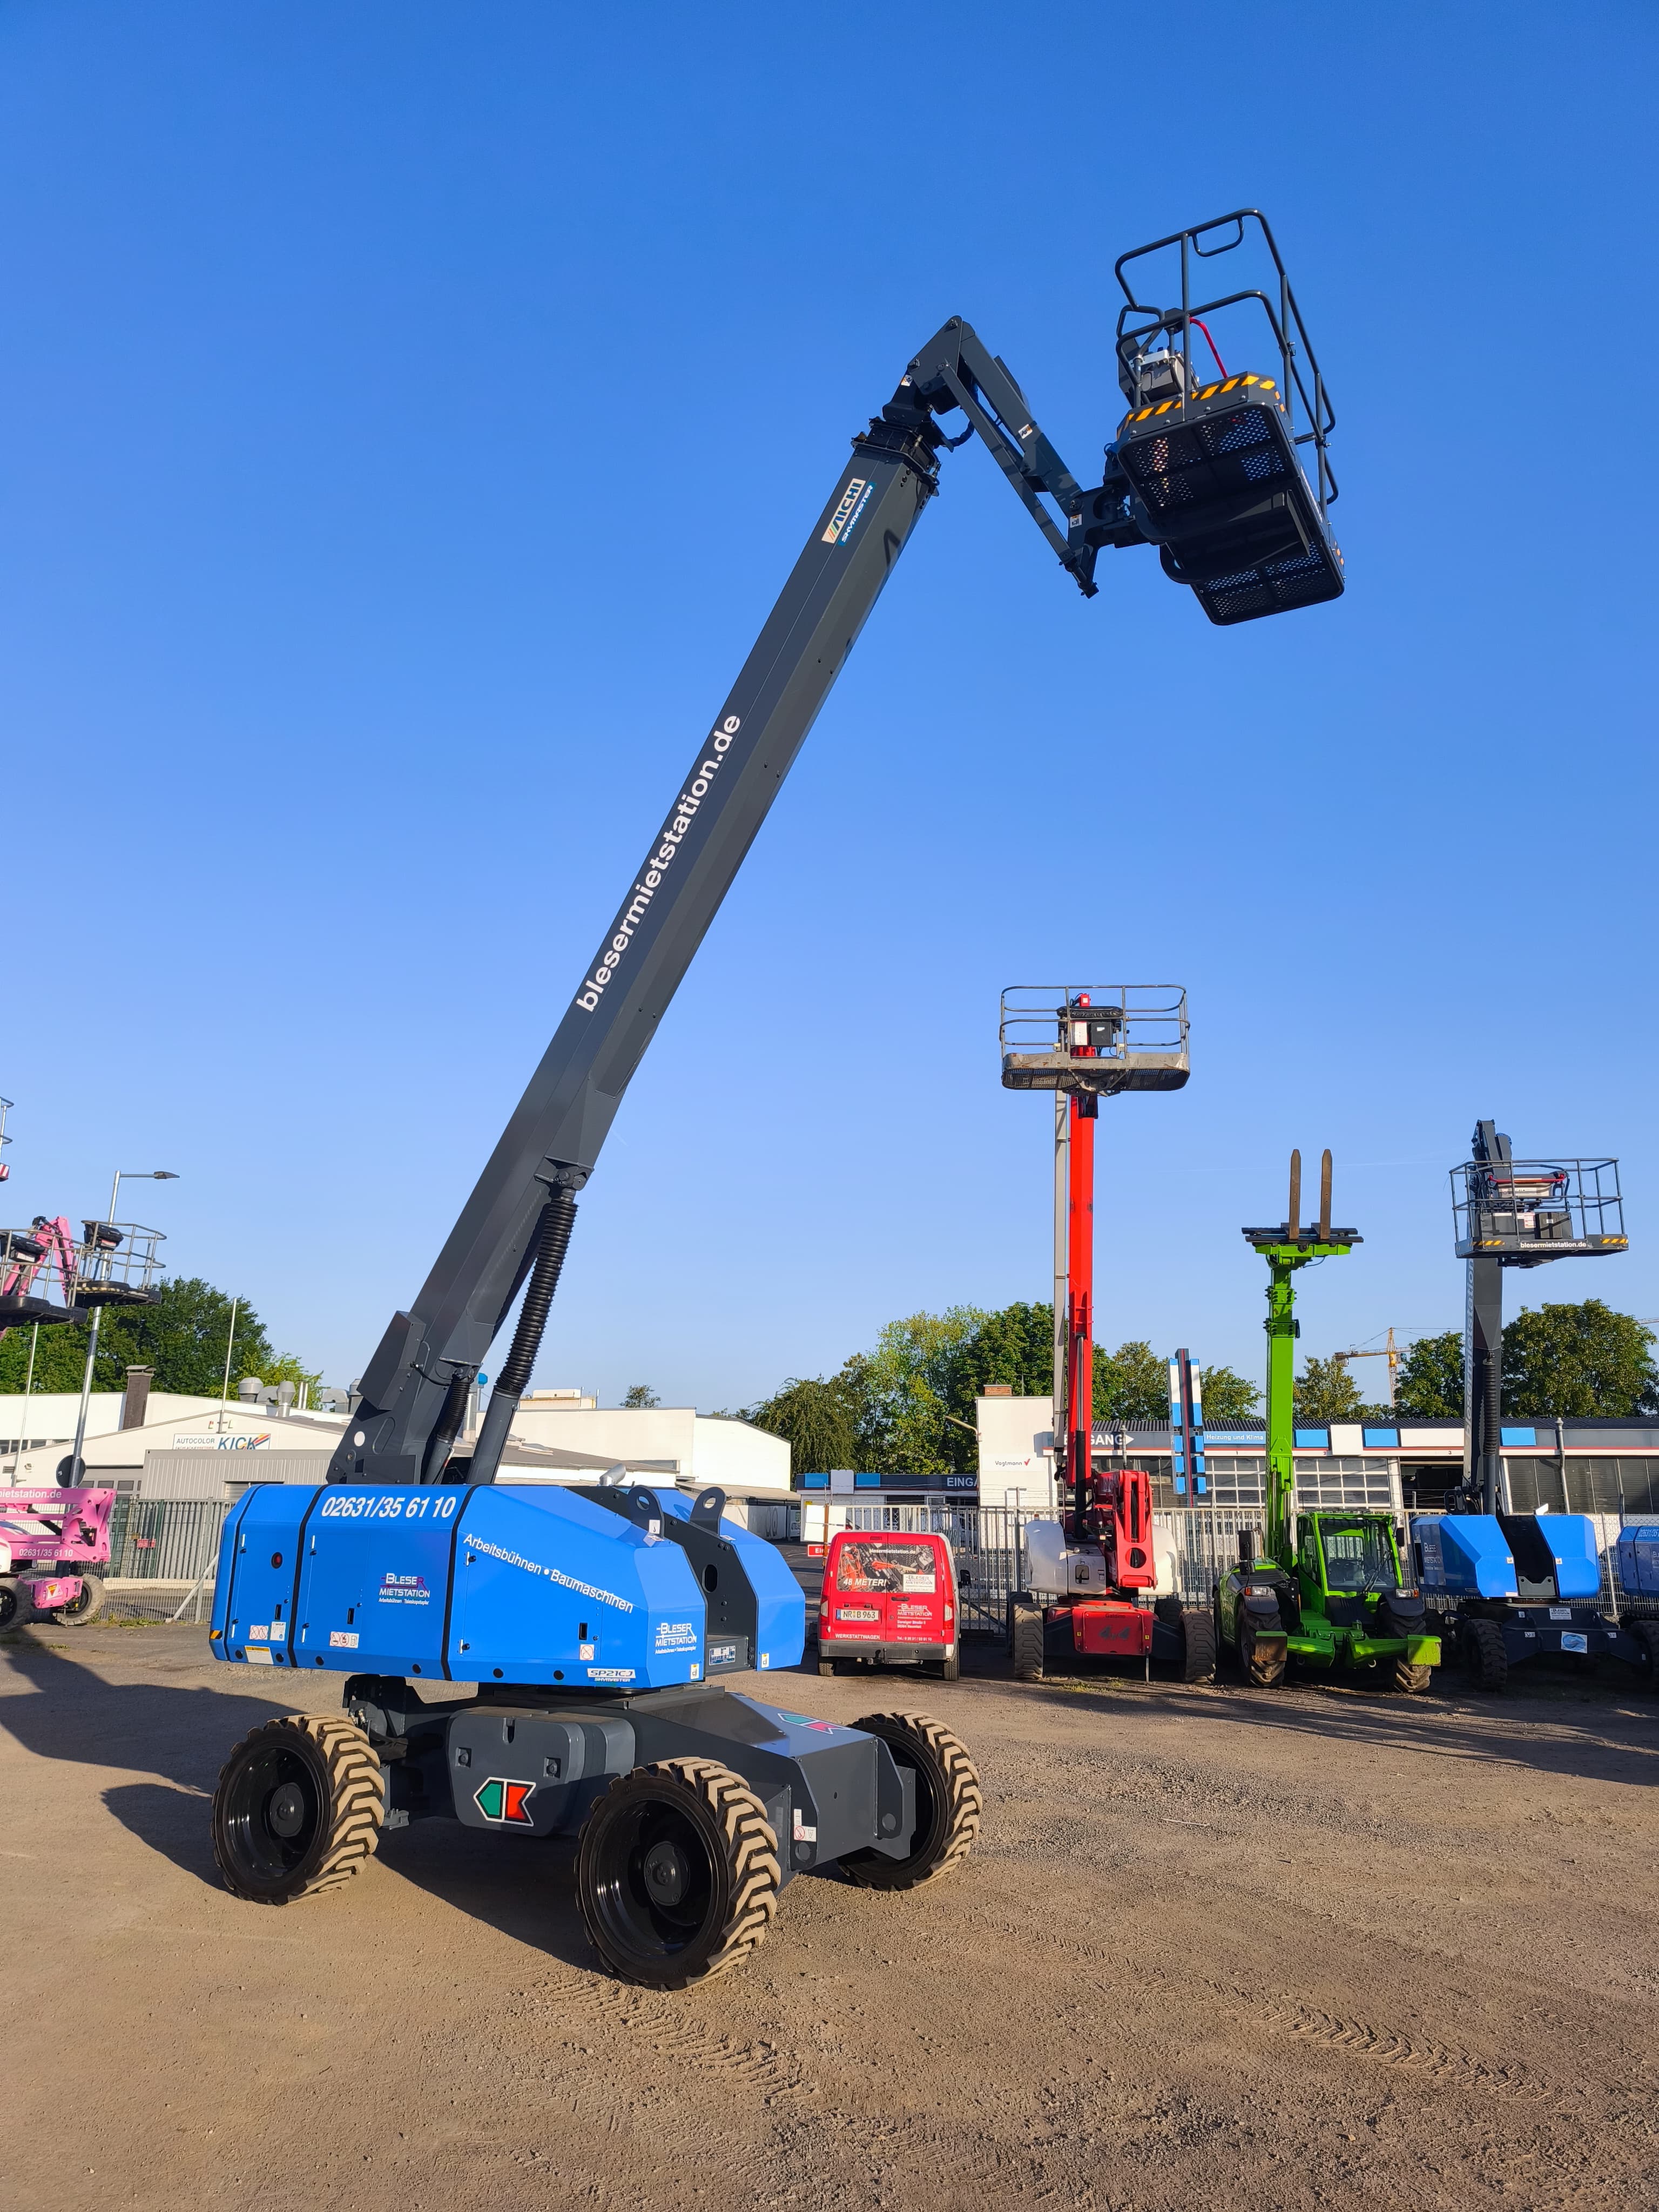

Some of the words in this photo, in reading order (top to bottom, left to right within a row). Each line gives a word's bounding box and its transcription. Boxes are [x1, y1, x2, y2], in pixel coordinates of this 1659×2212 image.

[832, 482, 862, 530] AICHI
[841, 485, 873, 543] SKYMASTER
[576, 715, 740, 1013] blesermietstation.de
[218, 1437, 258, 1450] KICK
[1064, 1434, 1123, 1446] EGANG
[0, 1489, 62, 1499] ietstation.de
[321, 1496, 406, 1518] 02631/35
[406, 1496, 430, 1518] 61
[432, 1496, 457, 1519] 10
[19, 1548, 52, 1557] 02631/35
[54, 1549, 62, 1557] 61
[64, 1549, 73, 1557] 10
[463, 1533, 542, 1575] Arbeitsbühnen
[550, 1569, 634, 1614] Baumaschinen
[386, 1573, 426, 1588] BLESER
[379, 1588, 430, 1598] MIETSTATION
[862, 1611, 875, 1619] 963
[660, 1622, 693, 1634] BLESER
[655, 1635, 697, 1647] MIETSTATION
